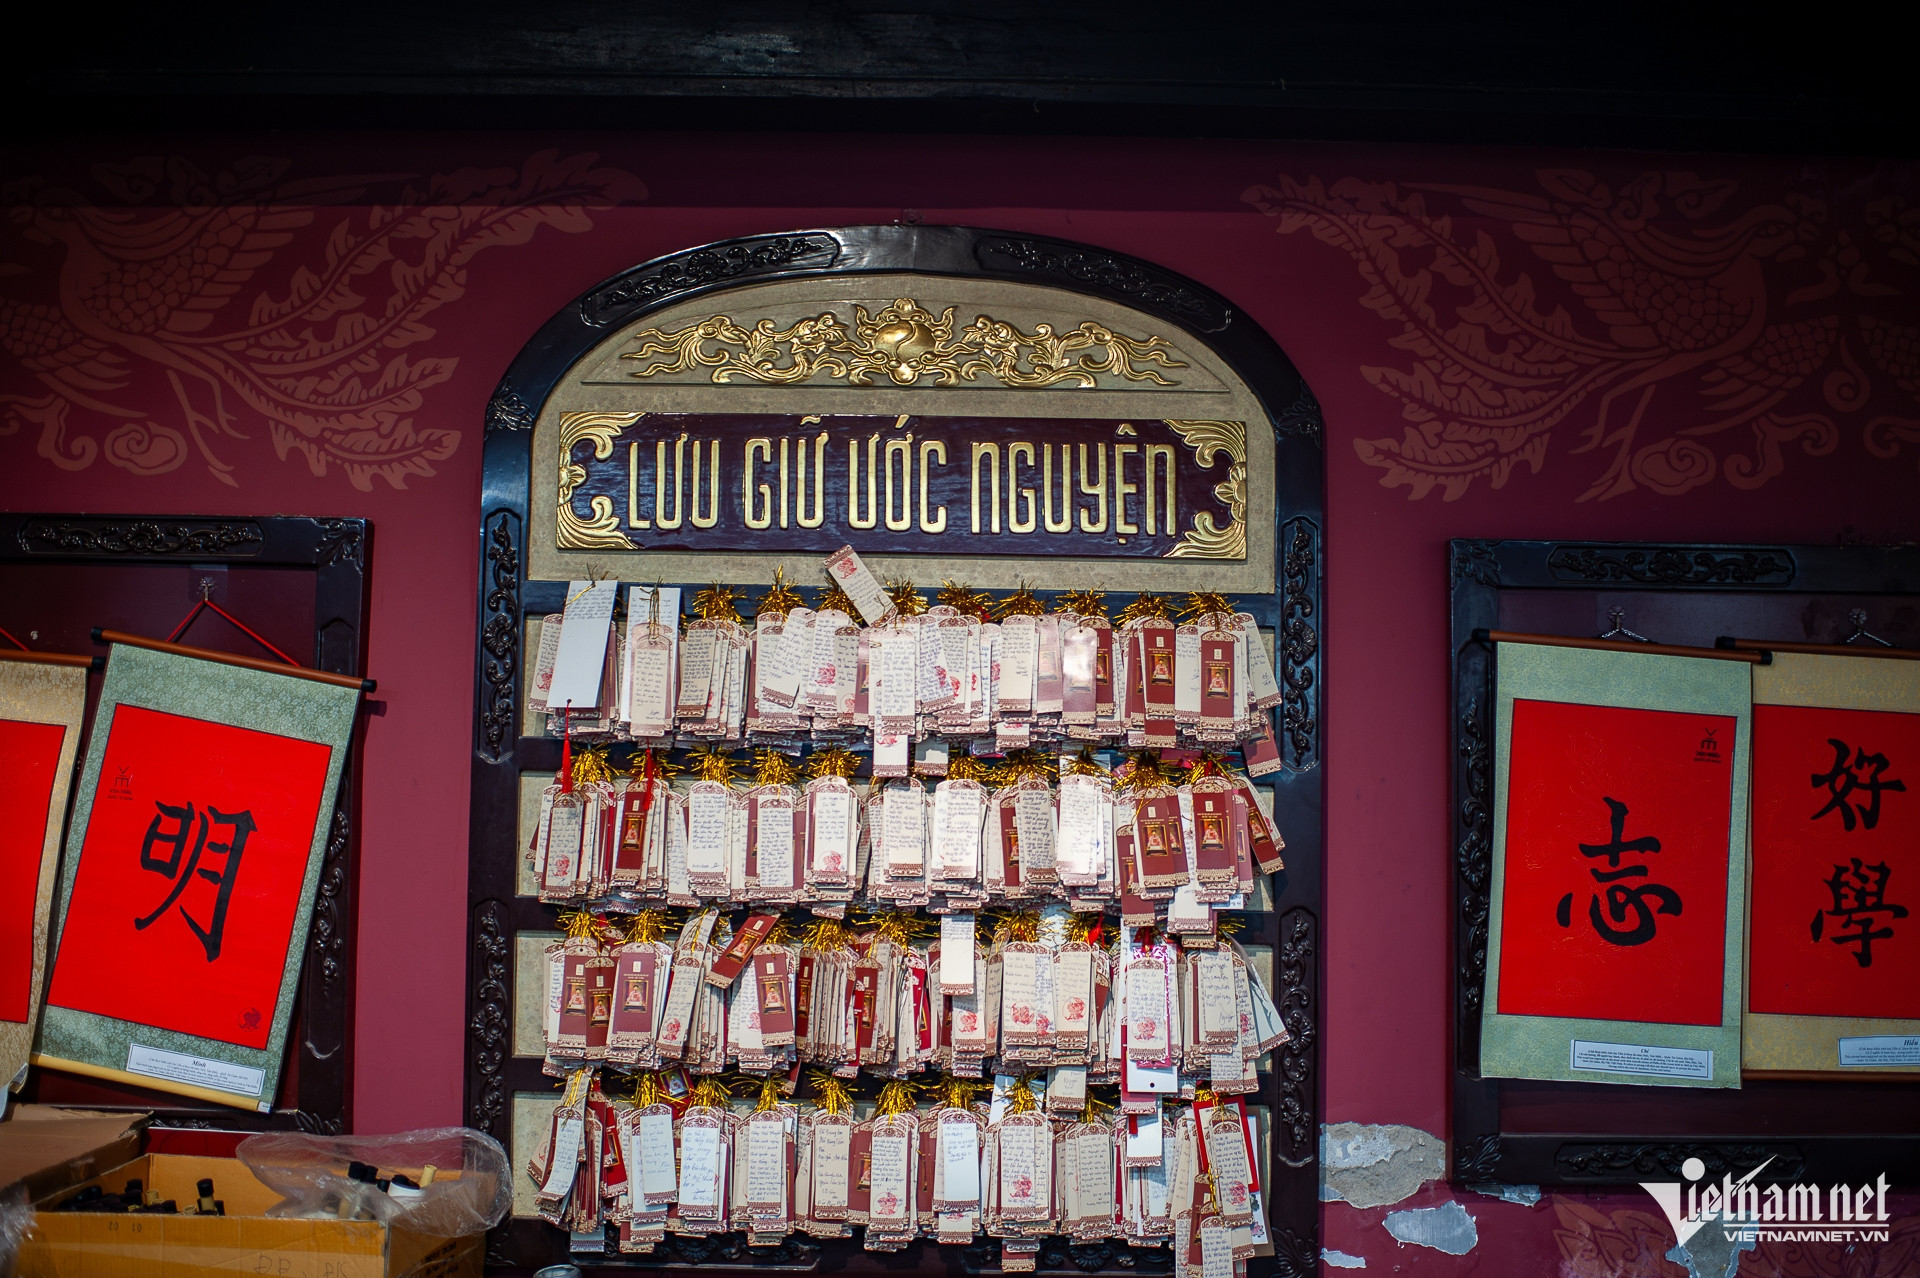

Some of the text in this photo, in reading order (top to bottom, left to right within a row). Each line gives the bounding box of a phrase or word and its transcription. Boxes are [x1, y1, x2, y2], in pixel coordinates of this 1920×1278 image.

[628, 414, 1176, 545] LƯU GIỮ ƯỚC NGUYỆN
[135, 801, 257, 962] 明
[1556, 797, 1683, 946] 志
[1810, 738, 1910, 968] 好學
